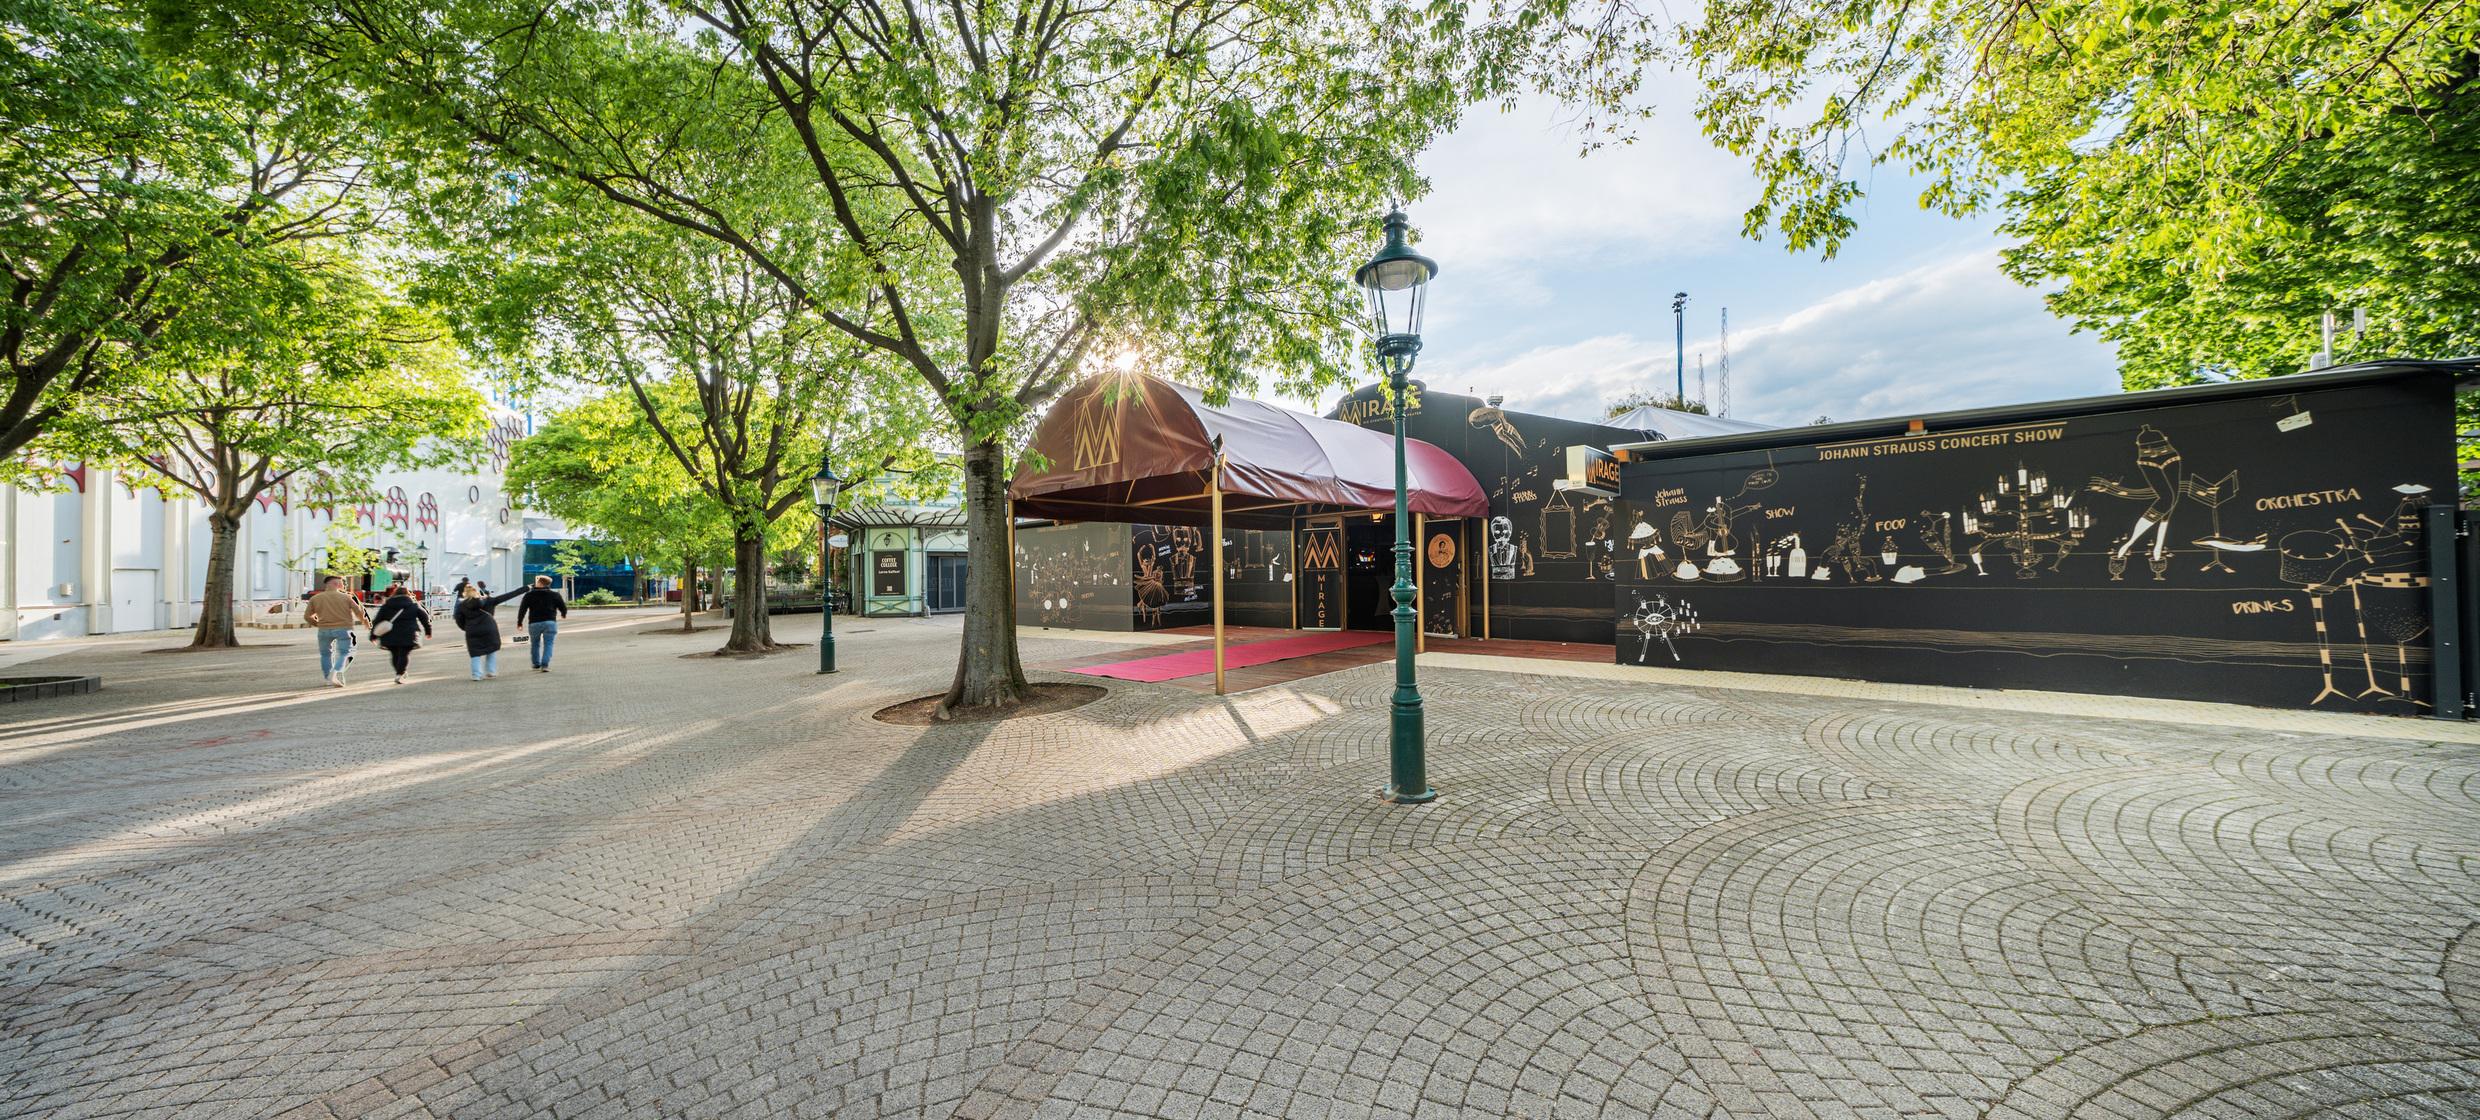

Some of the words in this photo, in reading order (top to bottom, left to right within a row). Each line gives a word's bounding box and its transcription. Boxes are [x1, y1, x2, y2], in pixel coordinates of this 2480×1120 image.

[1340, 391, 1421, 425] MIRAE
[1819, 447, 1869, 461] JOHANN
[1873, 440, 1936, 456] STRAUSS
[1940, 432, 2010, 450] CONCERT
[2014, 428, 2063, 443] SHOW
[1586, 453, 1620, 485] MIRAGE
[1655, 488, 1684, 499] Johann
[1655, 496, 1688, 507] Strauss
[2256, 488, 2362, 511] ORCHESTRA
[1765, 506, 1795, 520] SHOW
[1875, 518, 1906, 532] FOOD
[1317, 574, 1326, 628] MIRAGE
[2232, 599, 2294, 615] DRINKS
